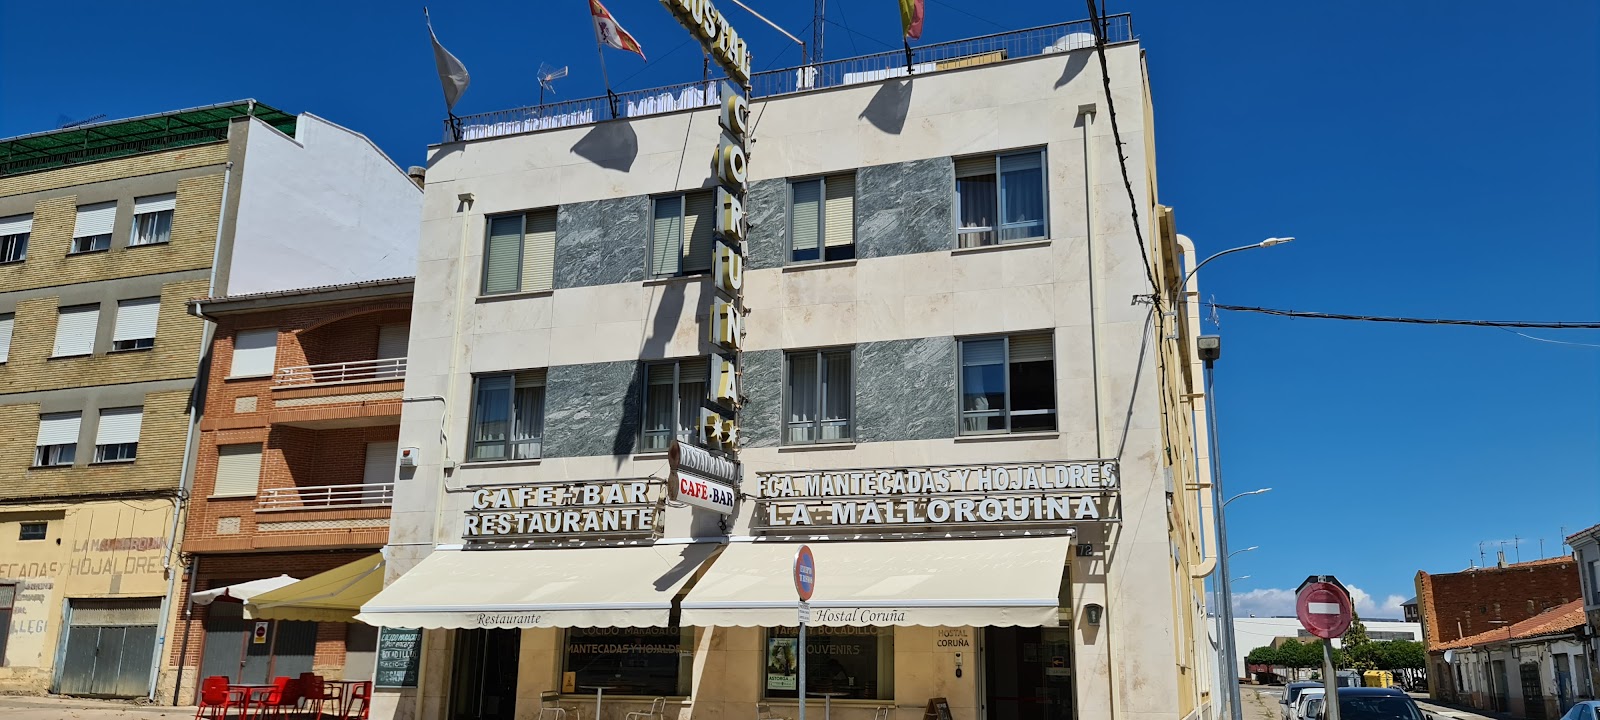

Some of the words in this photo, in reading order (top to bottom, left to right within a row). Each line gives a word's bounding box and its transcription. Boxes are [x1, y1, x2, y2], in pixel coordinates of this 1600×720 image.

[679, 446, 735, 480] RESTAURANTE
[804, 469, 951, 498] MANTECADAS
[956, 468, 971, 492] Y
[977, 463, 1117, 491] HOJALDRES
[583, 482, 650, 505] BAR
[769, 502, 813, 526] LA
[831, 495, 1100, 525] MALLORQUINA
[463, 508, 655, 536] RESTAURANTE
[1078, 545, 1092, 556] 72
[69, 555, 168, 576] HOJALDRES
[476, 612, 541, 625] Restaurante
[814, 608, 858, 623] Hostal
[860, 608, 905, 623] Coruña
[938, 629, 967, 637] HOSTAL
[568, 644, 629, 654] MANTECADAS
[807, 644, 860, 655] OUVENIRS
[936, 638, 969, 647] CORUÑA
